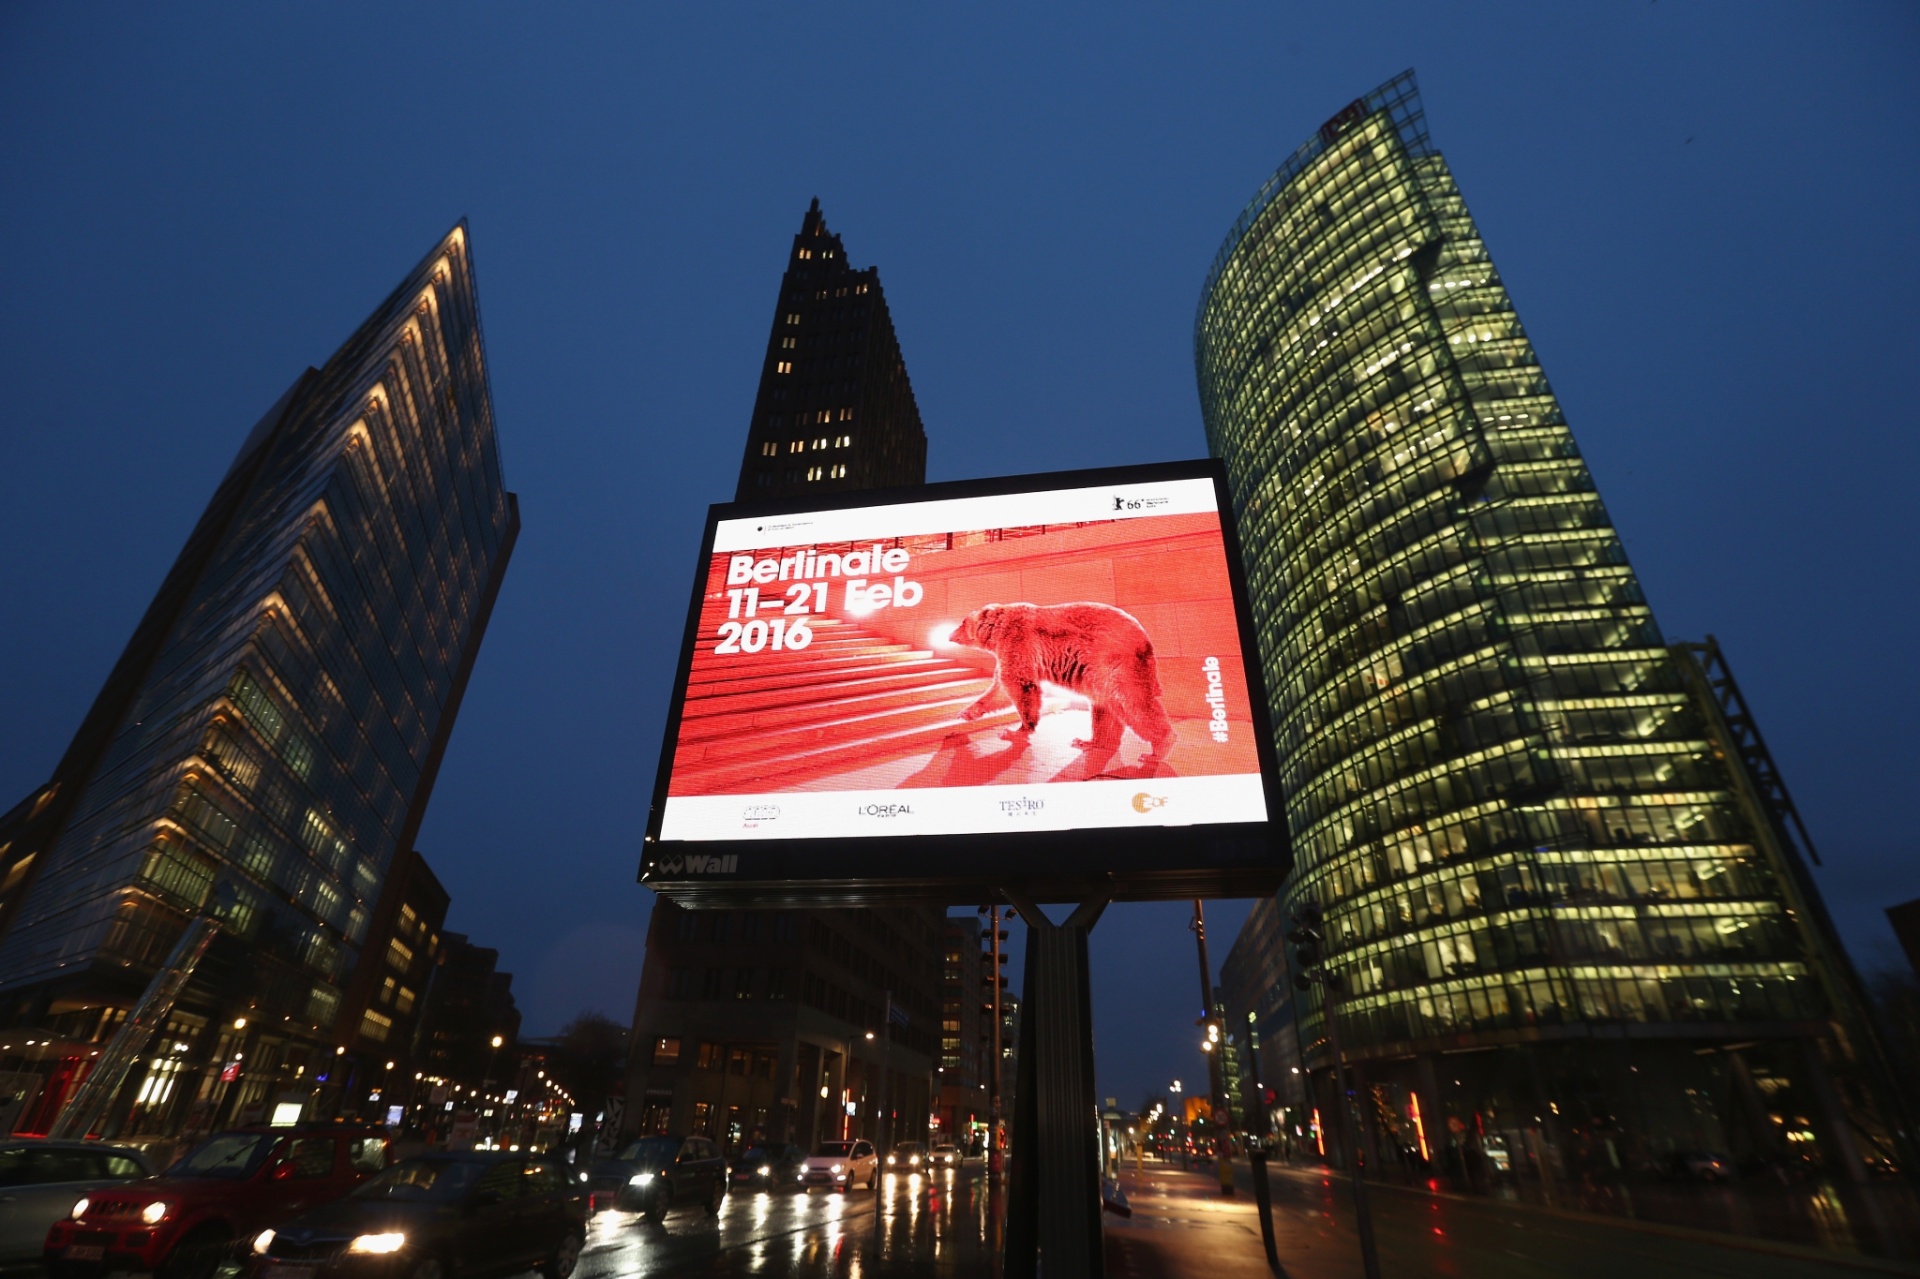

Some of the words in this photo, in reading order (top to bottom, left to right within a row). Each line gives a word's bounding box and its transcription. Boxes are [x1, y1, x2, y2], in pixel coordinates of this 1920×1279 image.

[727, 544, 910, 585] Berlinale
[844, 576, 923, 611] Feb
[714, 617, 813, 654] 2016
[1201, 656, 1229, 743] #Berlinale
[684, 853, 739, 874] Wall
